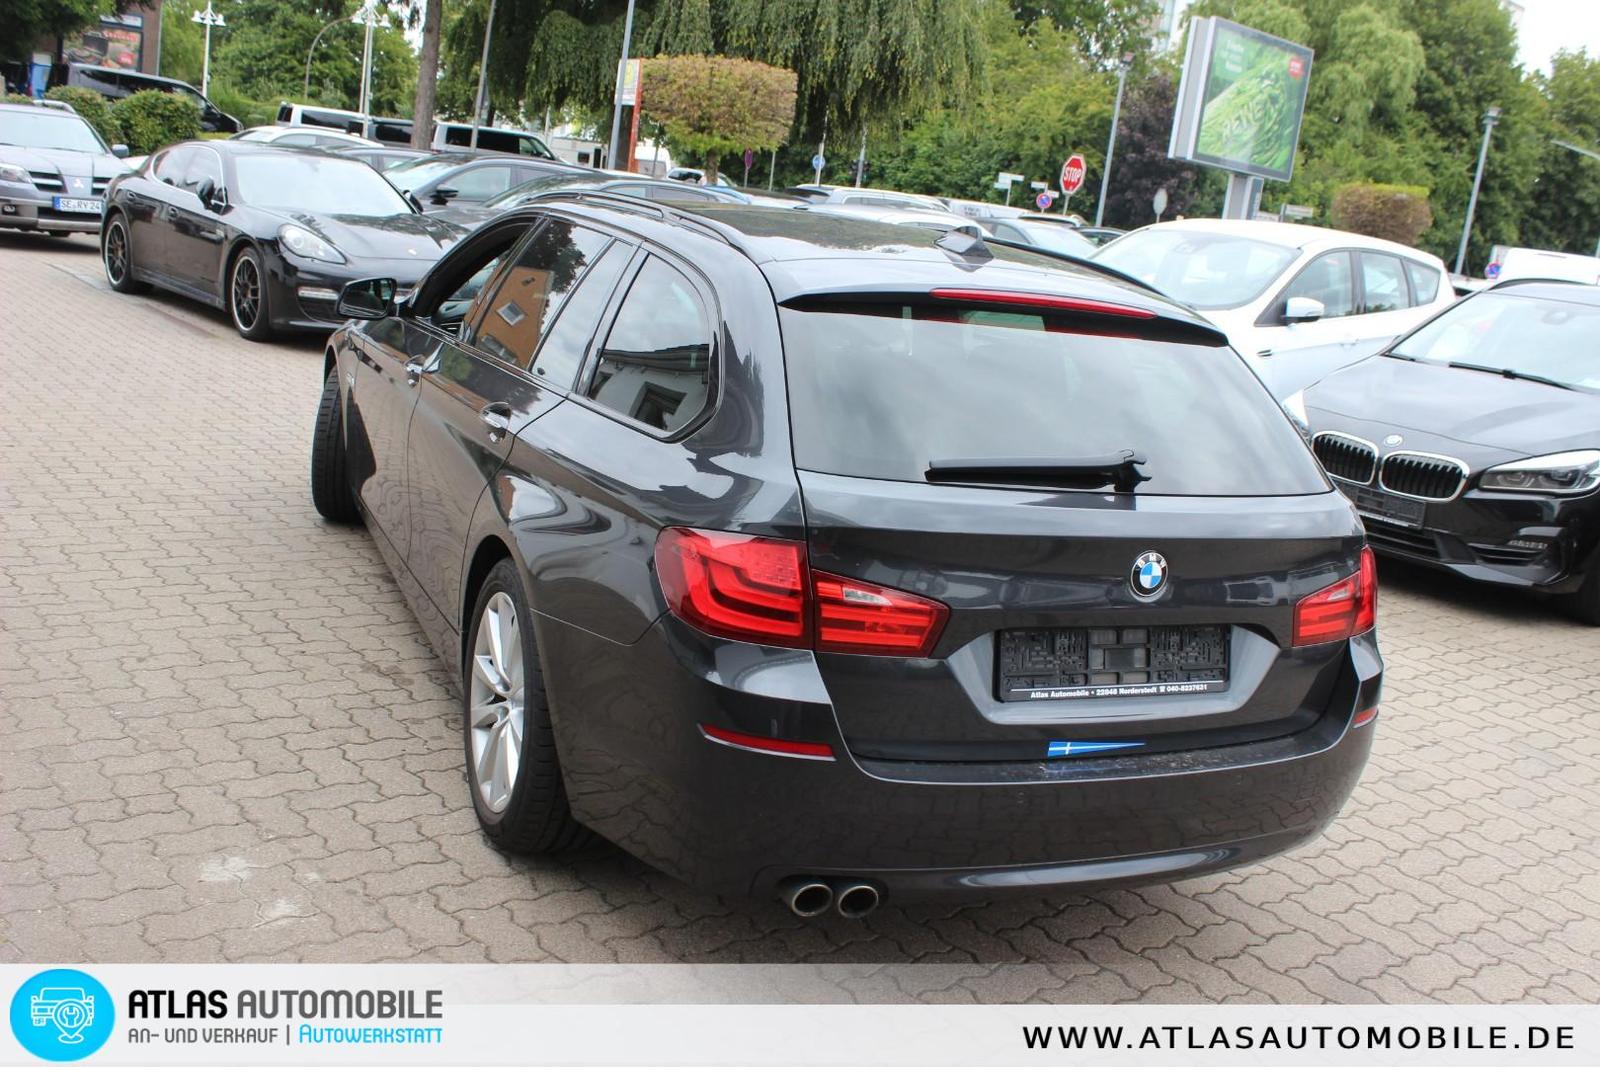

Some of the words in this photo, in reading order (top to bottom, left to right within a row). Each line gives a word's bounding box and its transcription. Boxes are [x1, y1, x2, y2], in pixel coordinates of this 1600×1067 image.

[1063, 167, 1082, 182] STOP
[1030, 691, 1049, 699] Atlas
[1050, 689, 1090, 698] Automobile
[1119, 685, 1157, 695] Norderstedt
